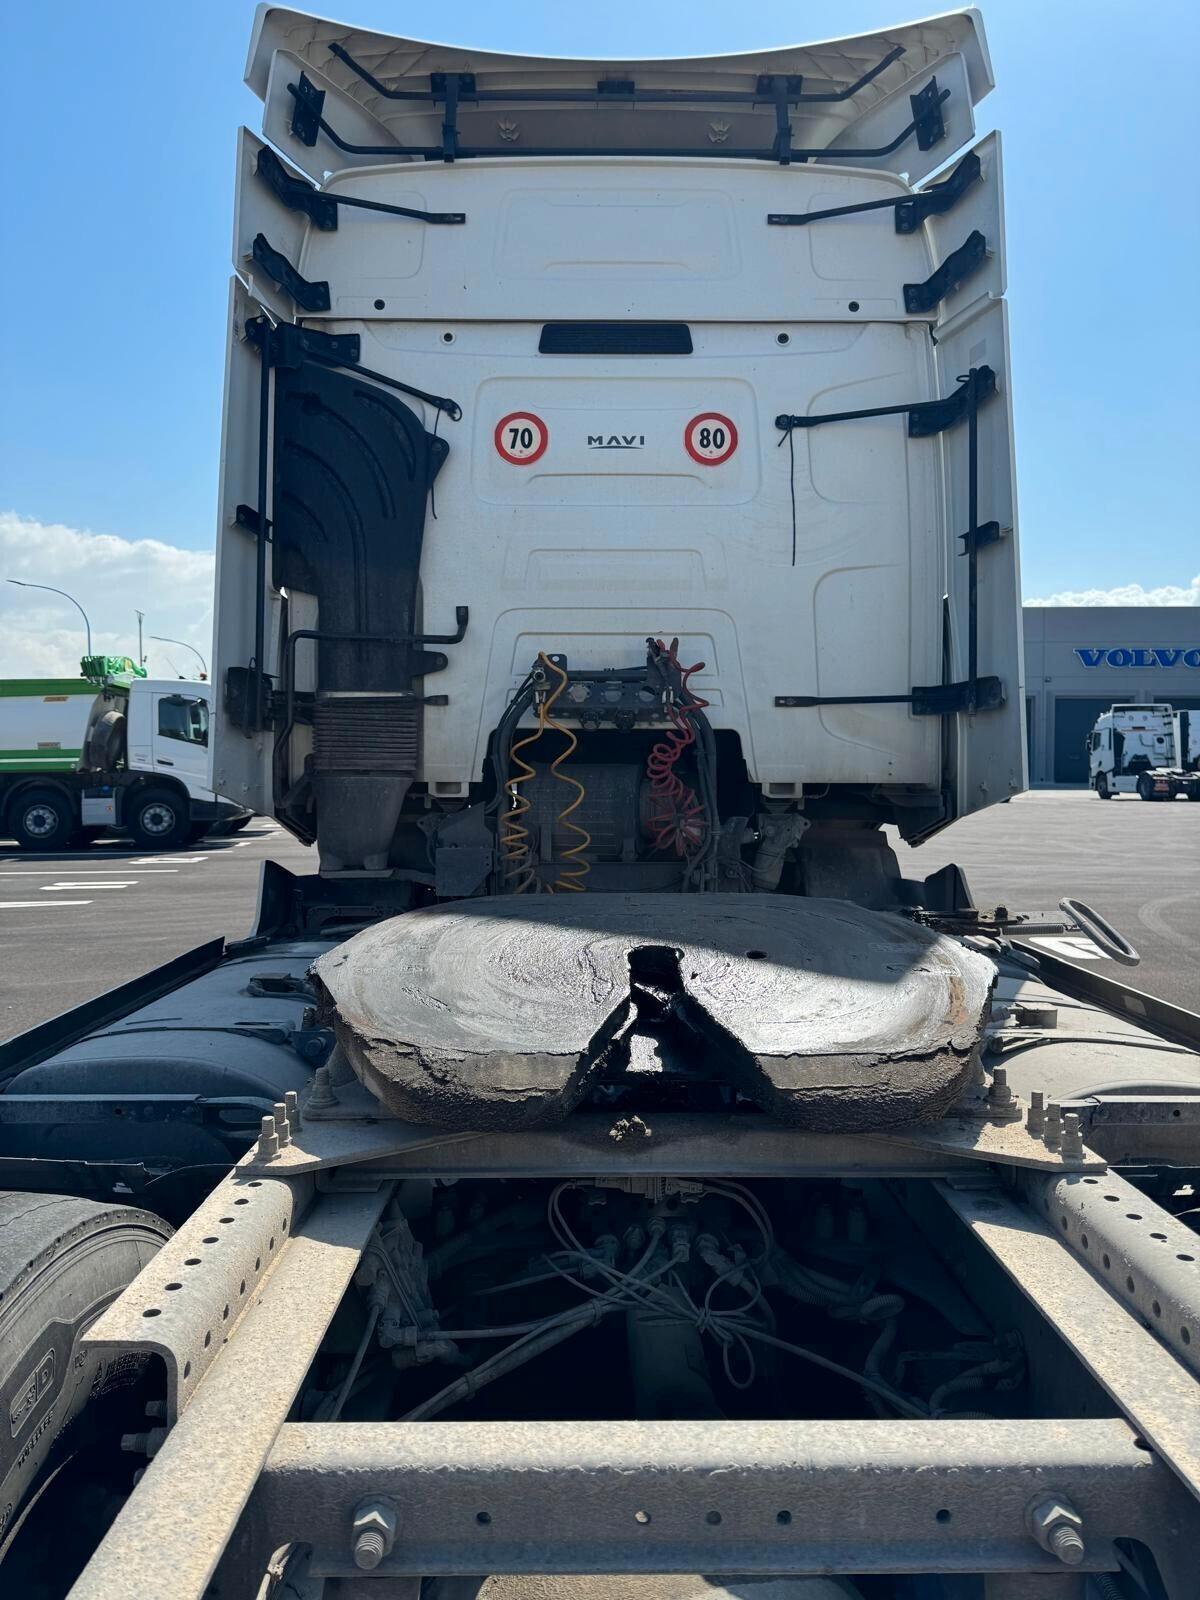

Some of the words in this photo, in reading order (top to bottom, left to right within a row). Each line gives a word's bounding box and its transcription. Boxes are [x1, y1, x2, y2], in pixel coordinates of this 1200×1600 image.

[509, 427, 533, 449] 70
[587, 435, 645, 446] MAVI
[699, 427, 725, 449] 80
[1073, 648, 1200, 669] VOLVO
